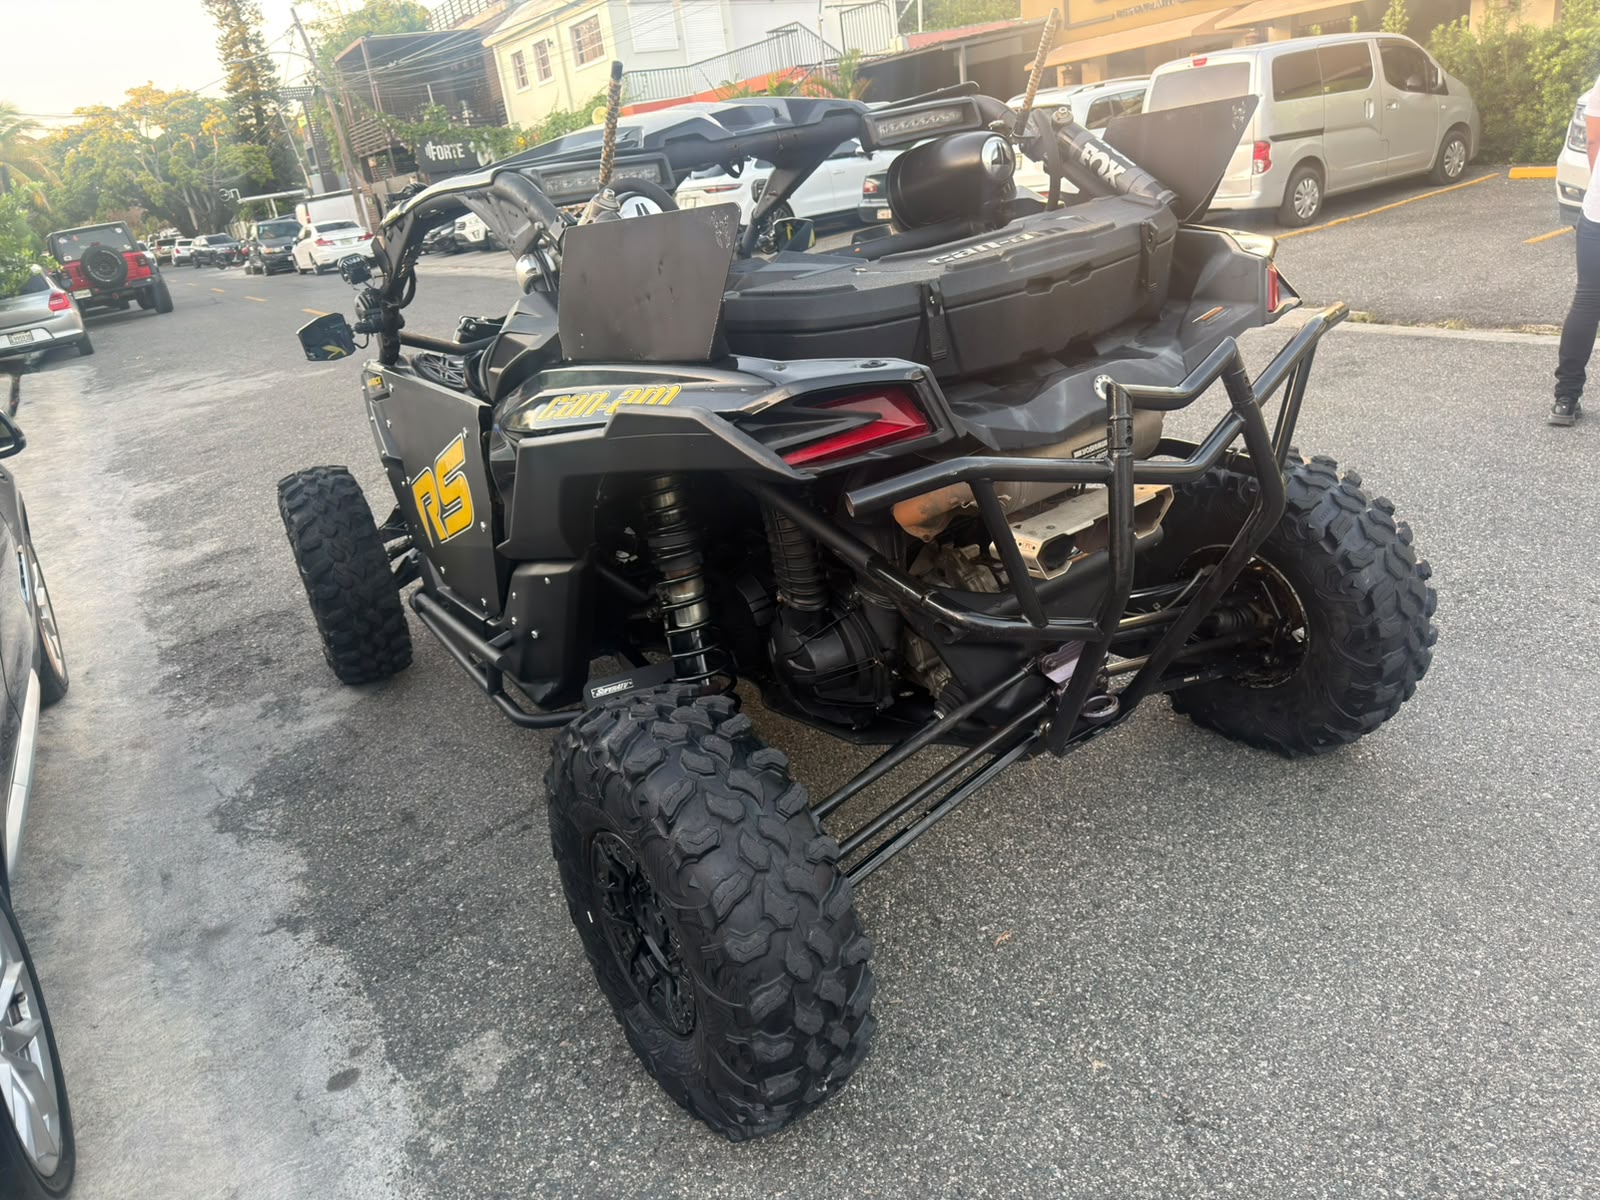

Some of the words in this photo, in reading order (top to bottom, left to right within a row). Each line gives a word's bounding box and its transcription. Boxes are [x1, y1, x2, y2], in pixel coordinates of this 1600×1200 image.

[431, 143, 465, 161] FORTE
[1081, 142, 1126, 188] FOX
[411, 432, 475, 548] RS
